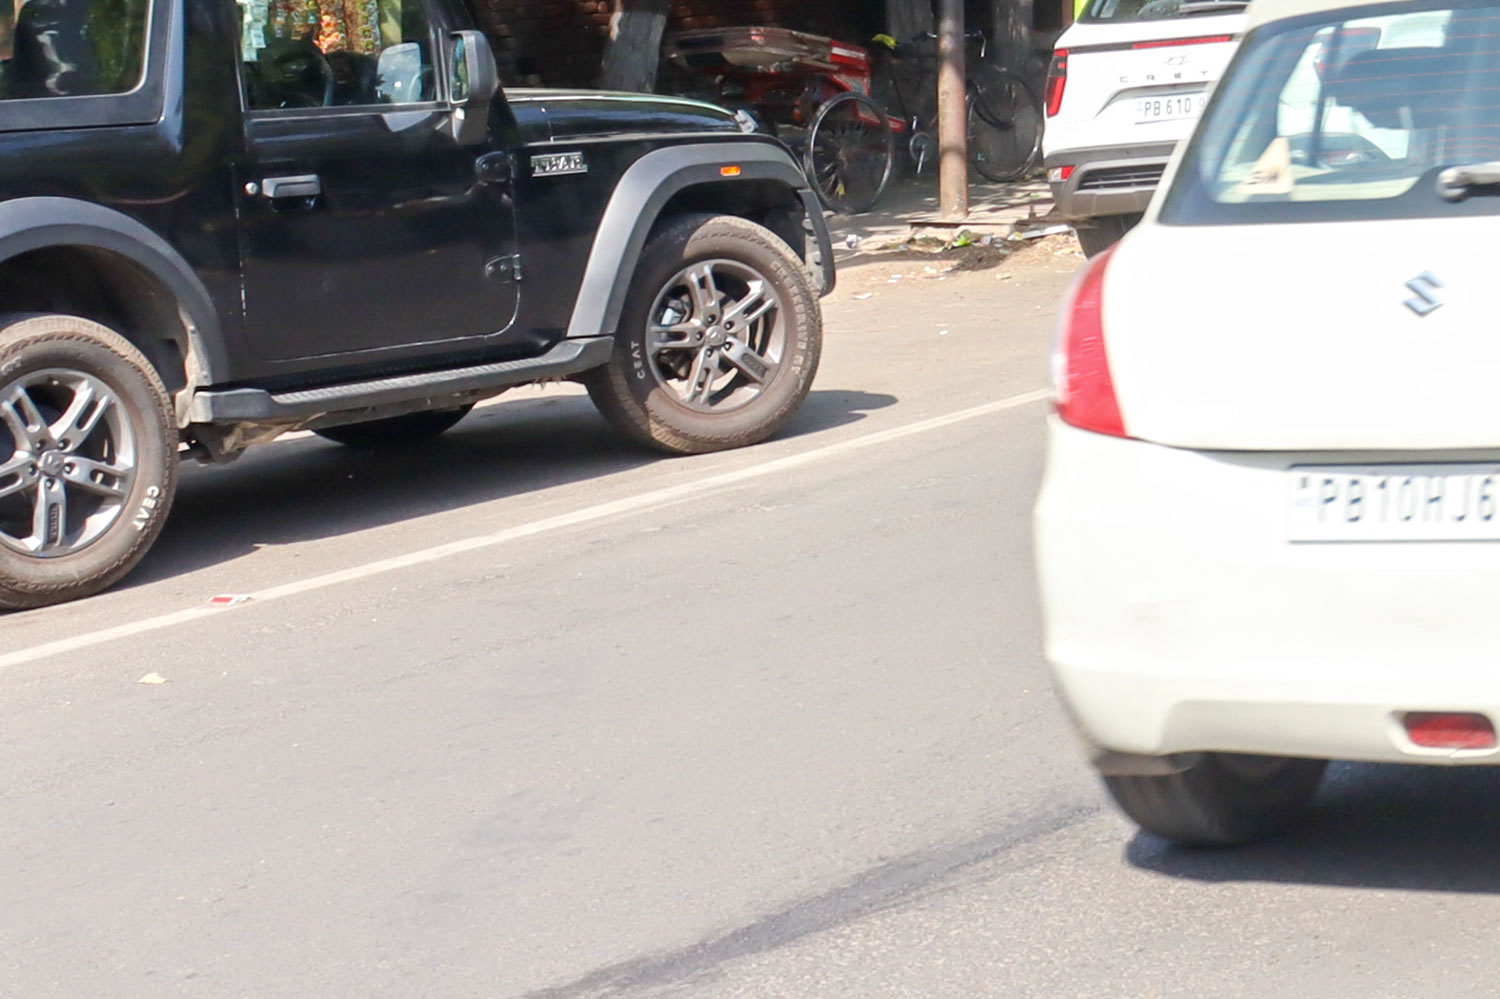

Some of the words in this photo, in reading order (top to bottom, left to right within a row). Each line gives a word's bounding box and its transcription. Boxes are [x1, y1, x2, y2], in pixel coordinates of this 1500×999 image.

[1119, 70, 1209, 83] CRET
[1144, 100, 1161, 117] PB
[630, 340, 646, 380] CEAT
[133, 485, 160, 531] CEAT
